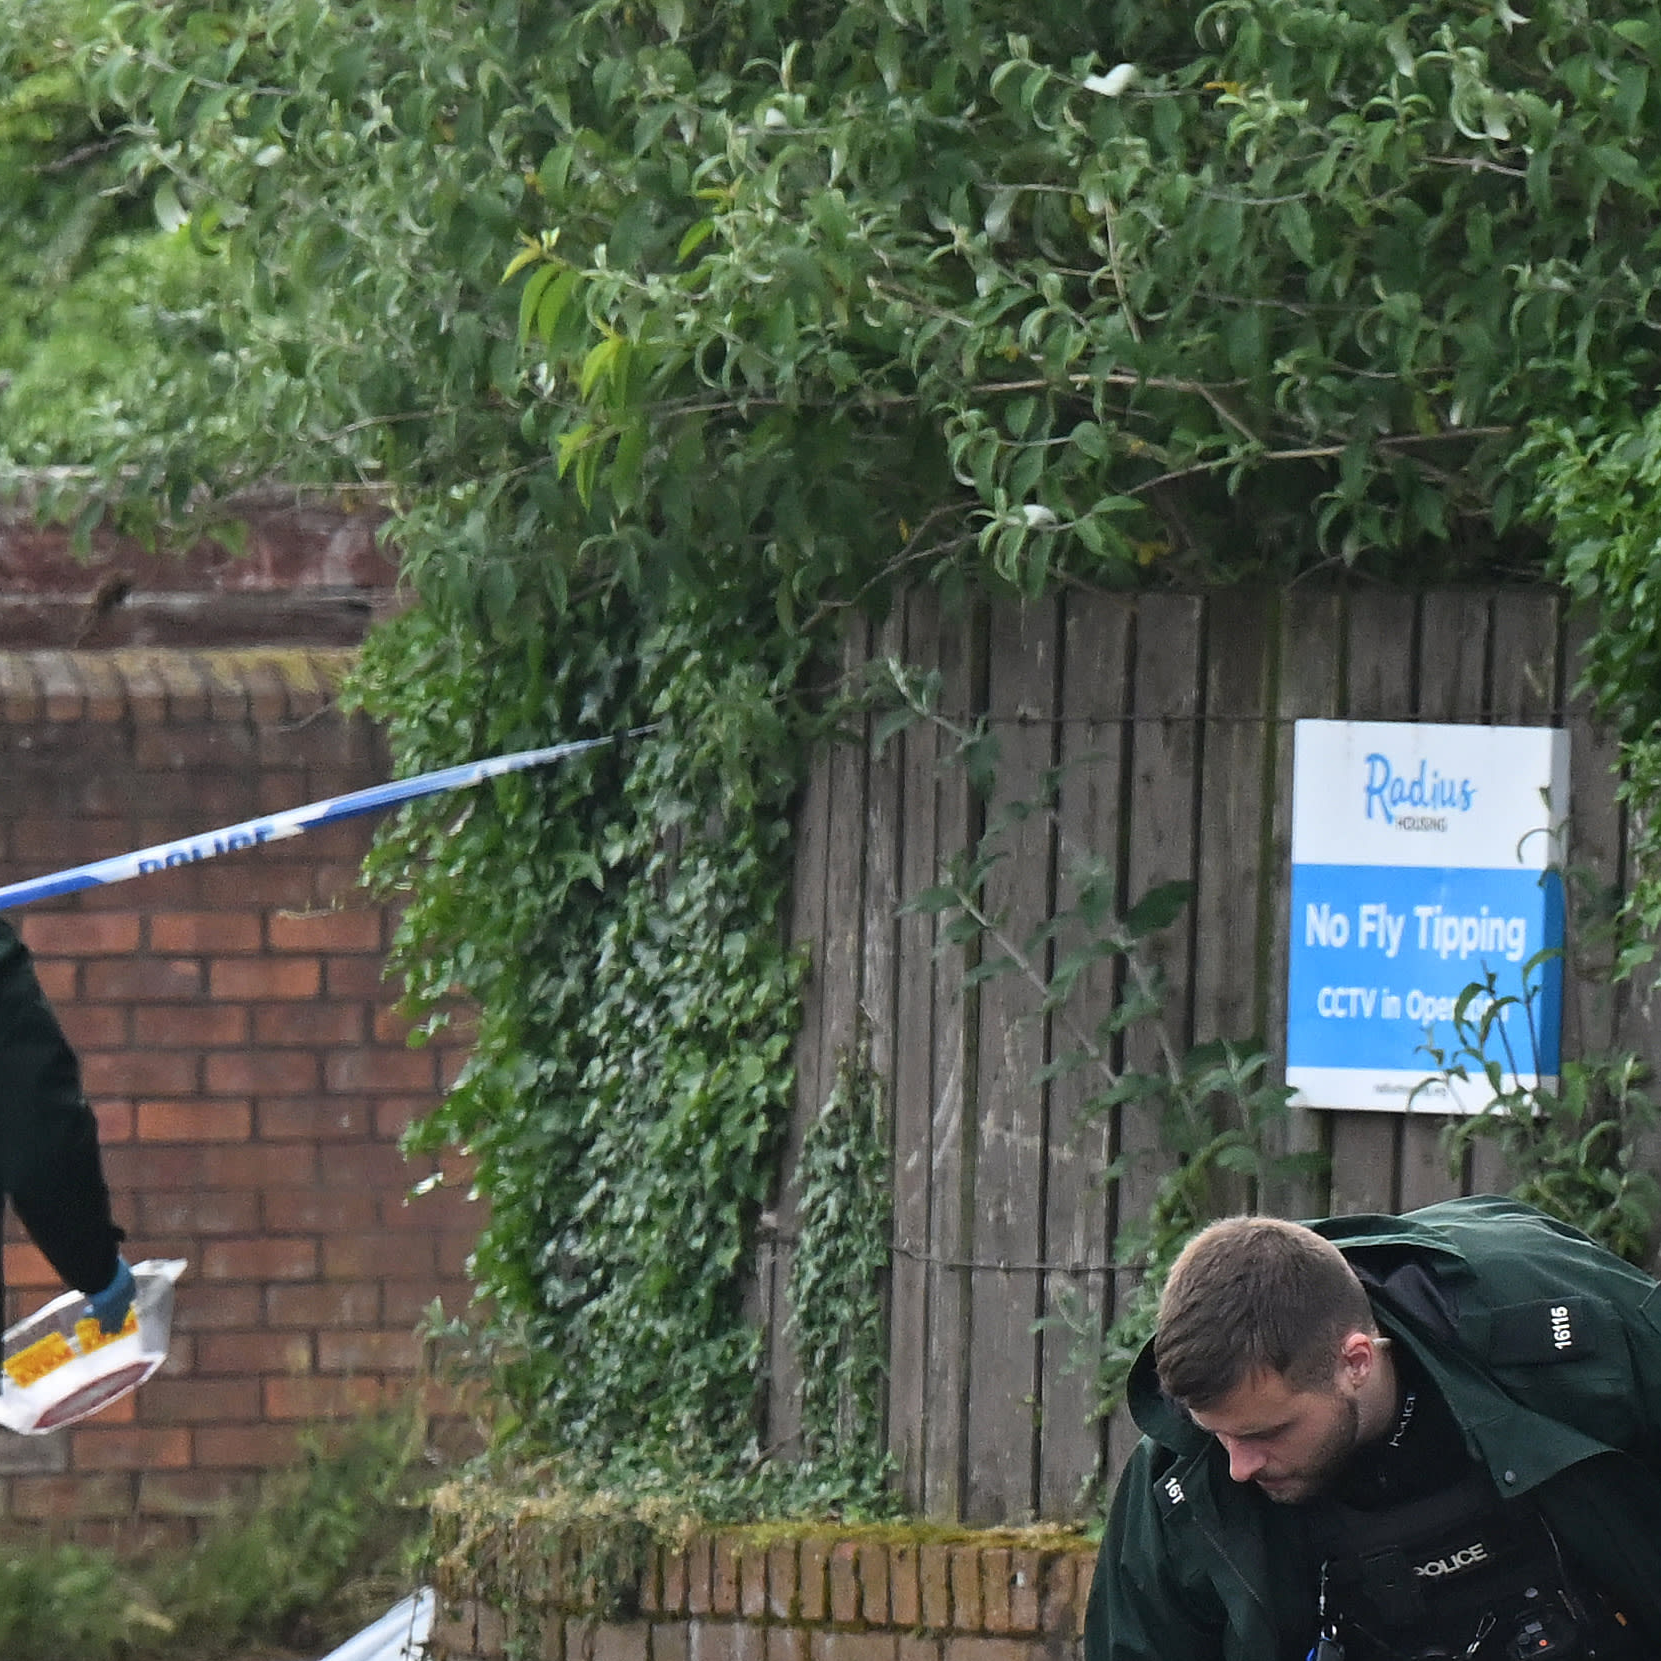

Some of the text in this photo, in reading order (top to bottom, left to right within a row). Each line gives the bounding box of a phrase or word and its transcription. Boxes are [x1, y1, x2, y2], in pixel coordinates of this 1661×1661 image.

[1365, 753, 1477, 824] Radius
[1305, 903, 1527, 962] No Fly Tipping
[1317, 986, 1377, 1018] CCTV
[1381, 988, 1401, 1020] in
[1550, 1306, 1572, 1350] 16115
[1165, 1477, 1186, 1504] 161
